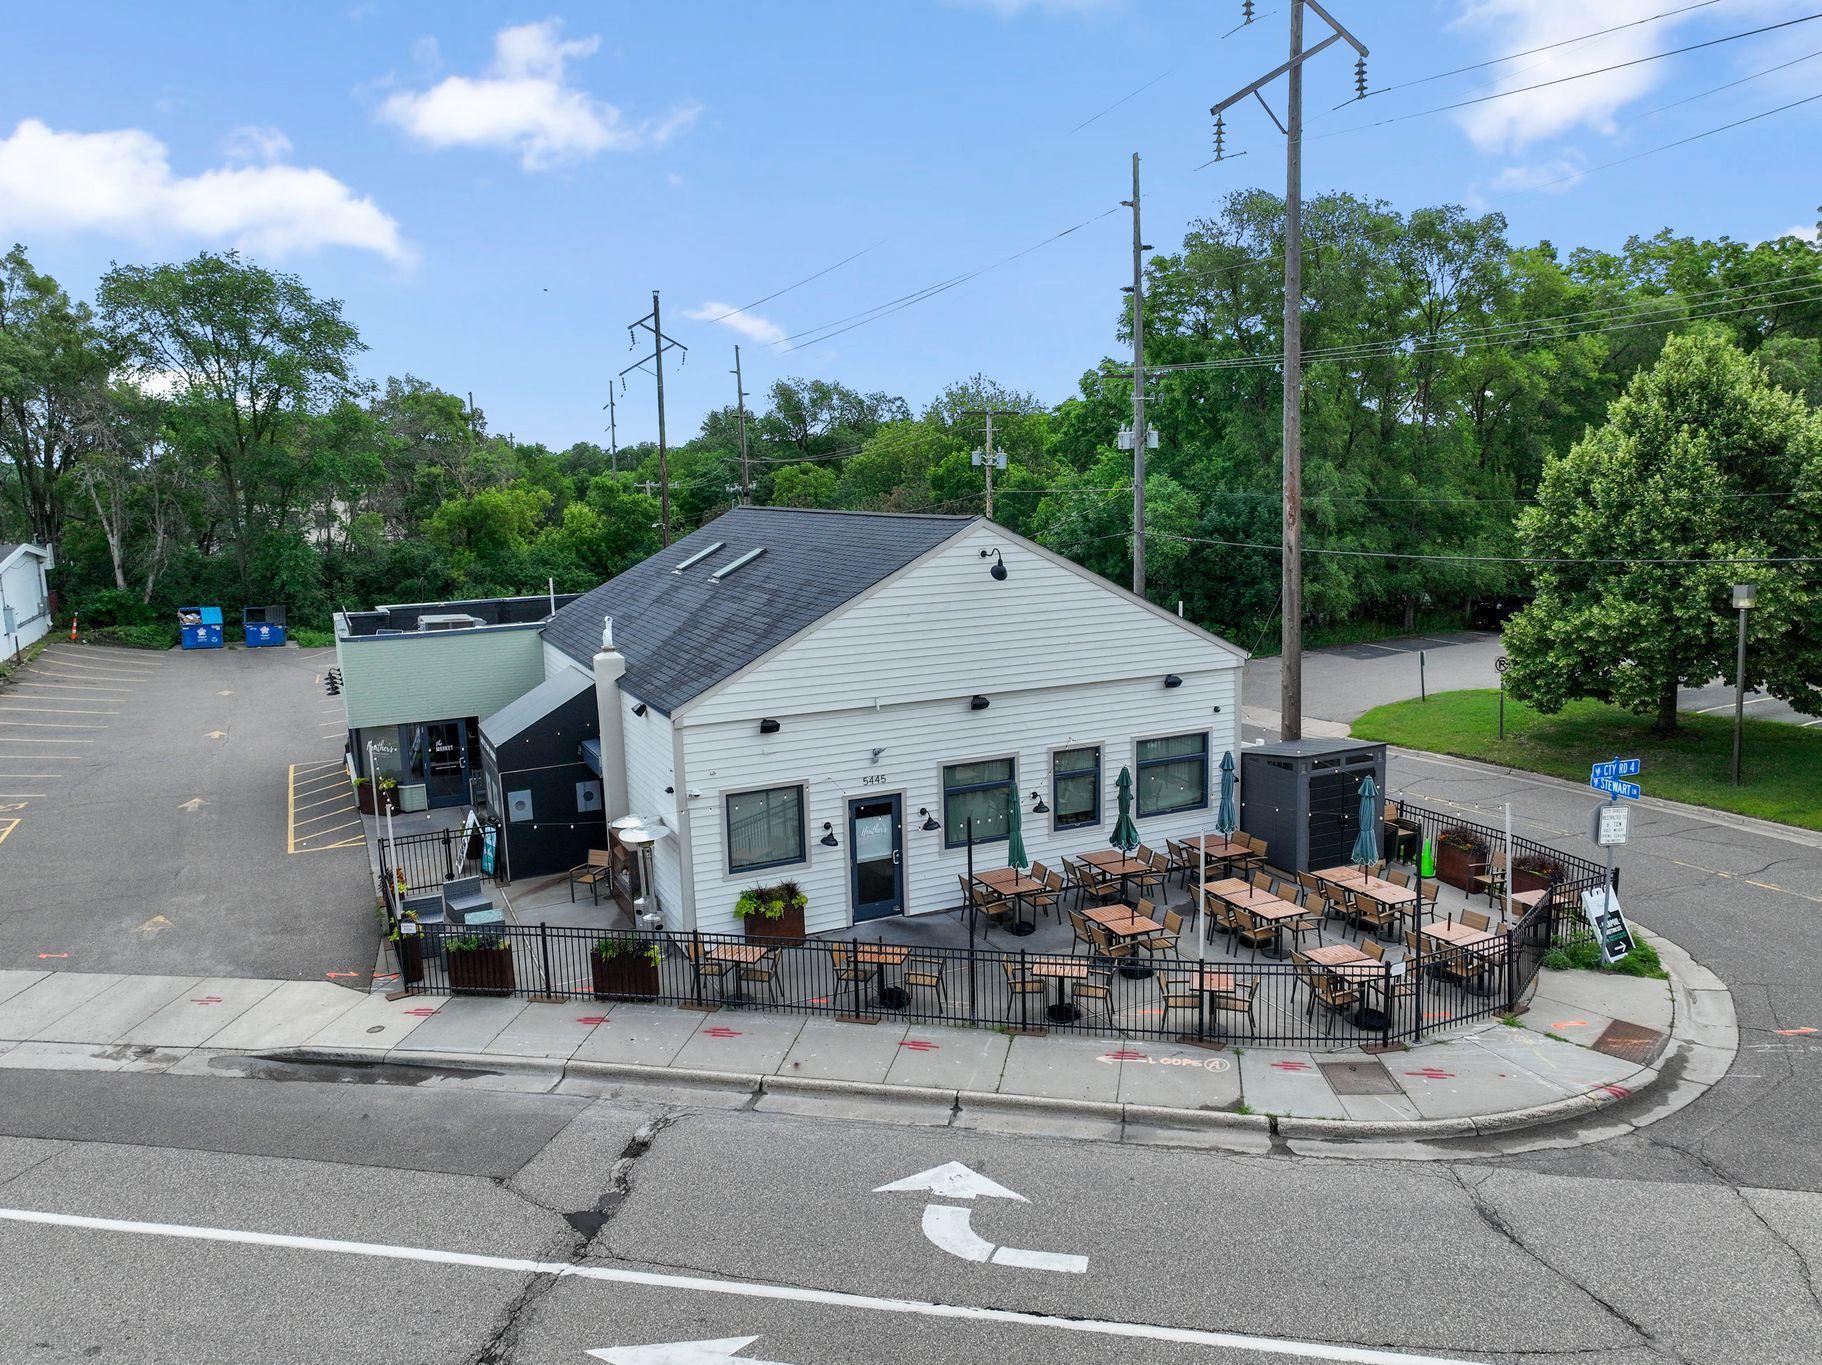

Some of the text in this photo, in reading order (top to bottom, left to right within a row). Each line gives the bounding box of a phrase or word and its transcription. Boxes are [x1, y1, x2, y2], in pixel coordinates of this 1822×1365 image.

[1604, 761, 1635, 776] CTY RD 4
[862, 774, 887, 786] 5445
[1600, 778, 1631, 796] STEWART
